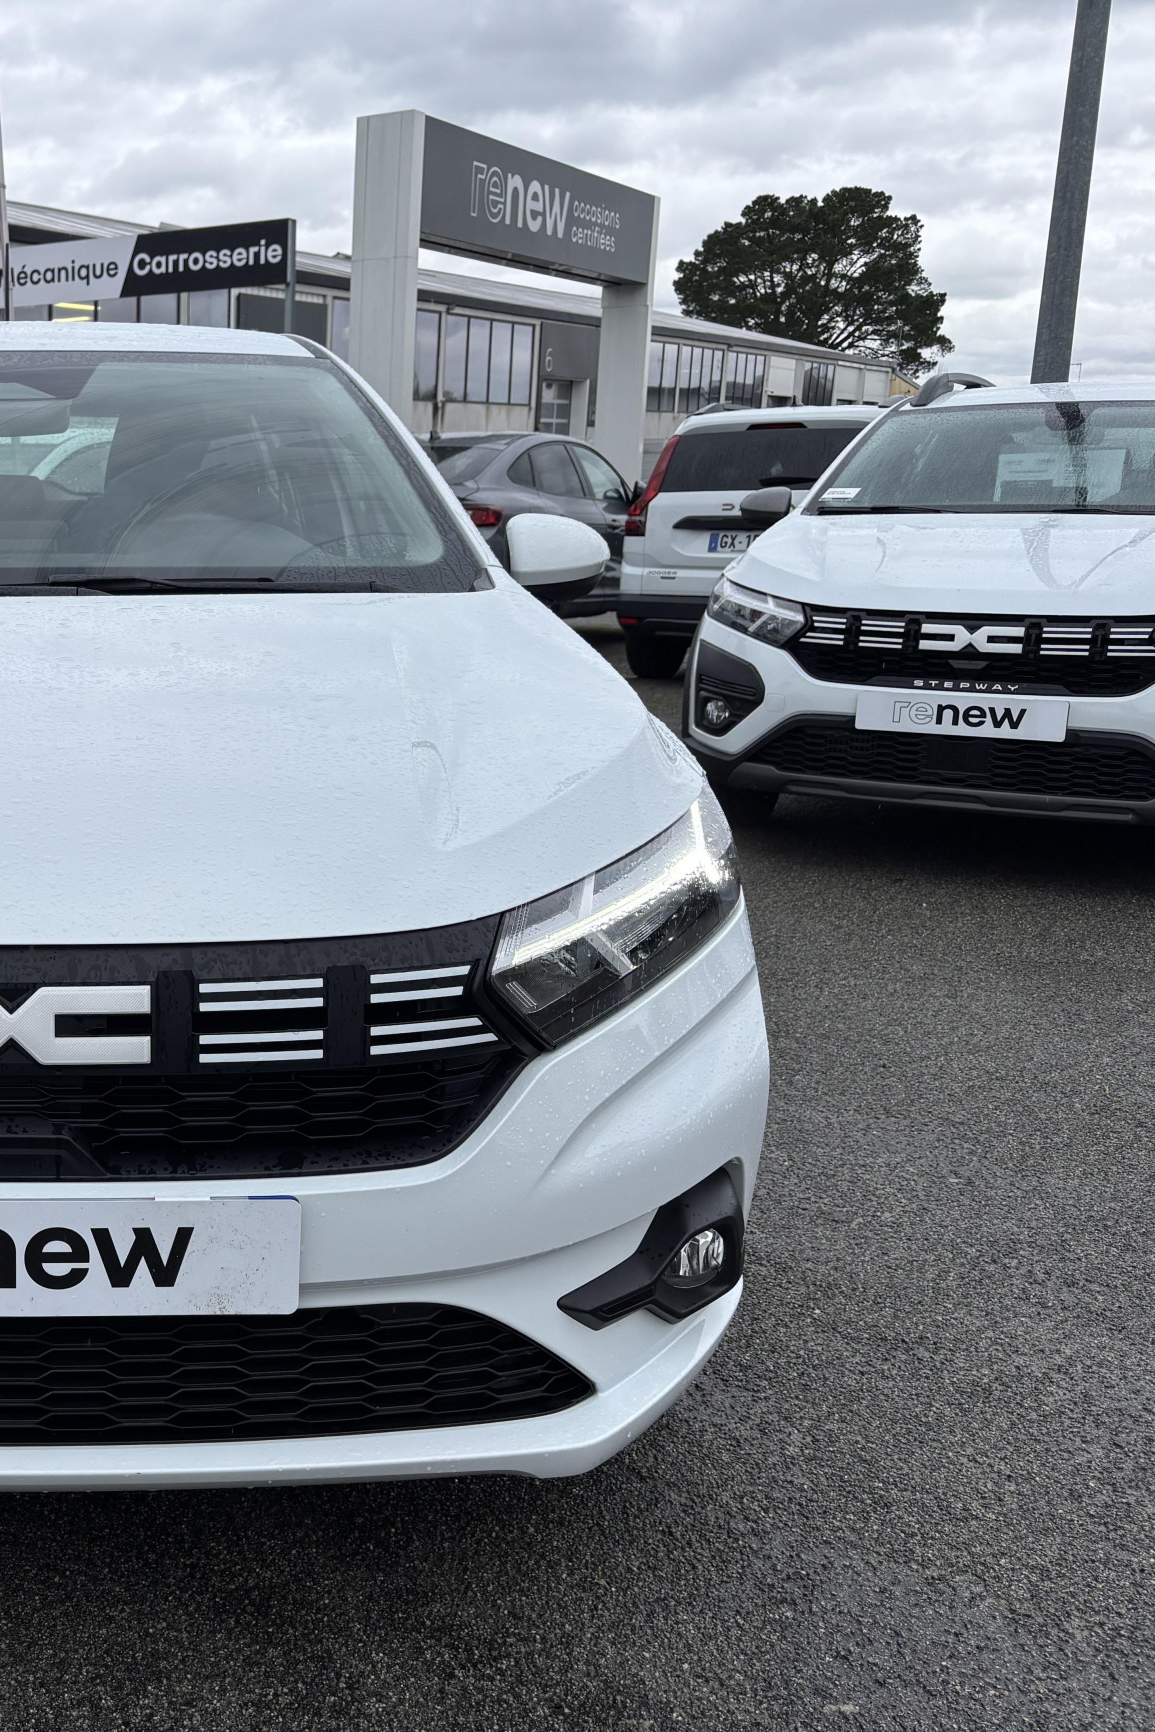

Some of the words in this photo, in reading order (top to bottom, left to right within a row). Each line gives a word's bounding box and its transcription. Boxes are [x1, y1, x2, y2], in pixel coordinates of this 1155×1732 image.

[470, 160, 571, 239] renew
[573, 200, 621, 229] occasions
[571, 226, 616, 252] certifiées
[132, 239, 283, 276] Carrosserie
[545, 348, 553, 372] 6
[913, 680, 1019, 692] STEPWAY
[892, 701, 1027, 730] renew
